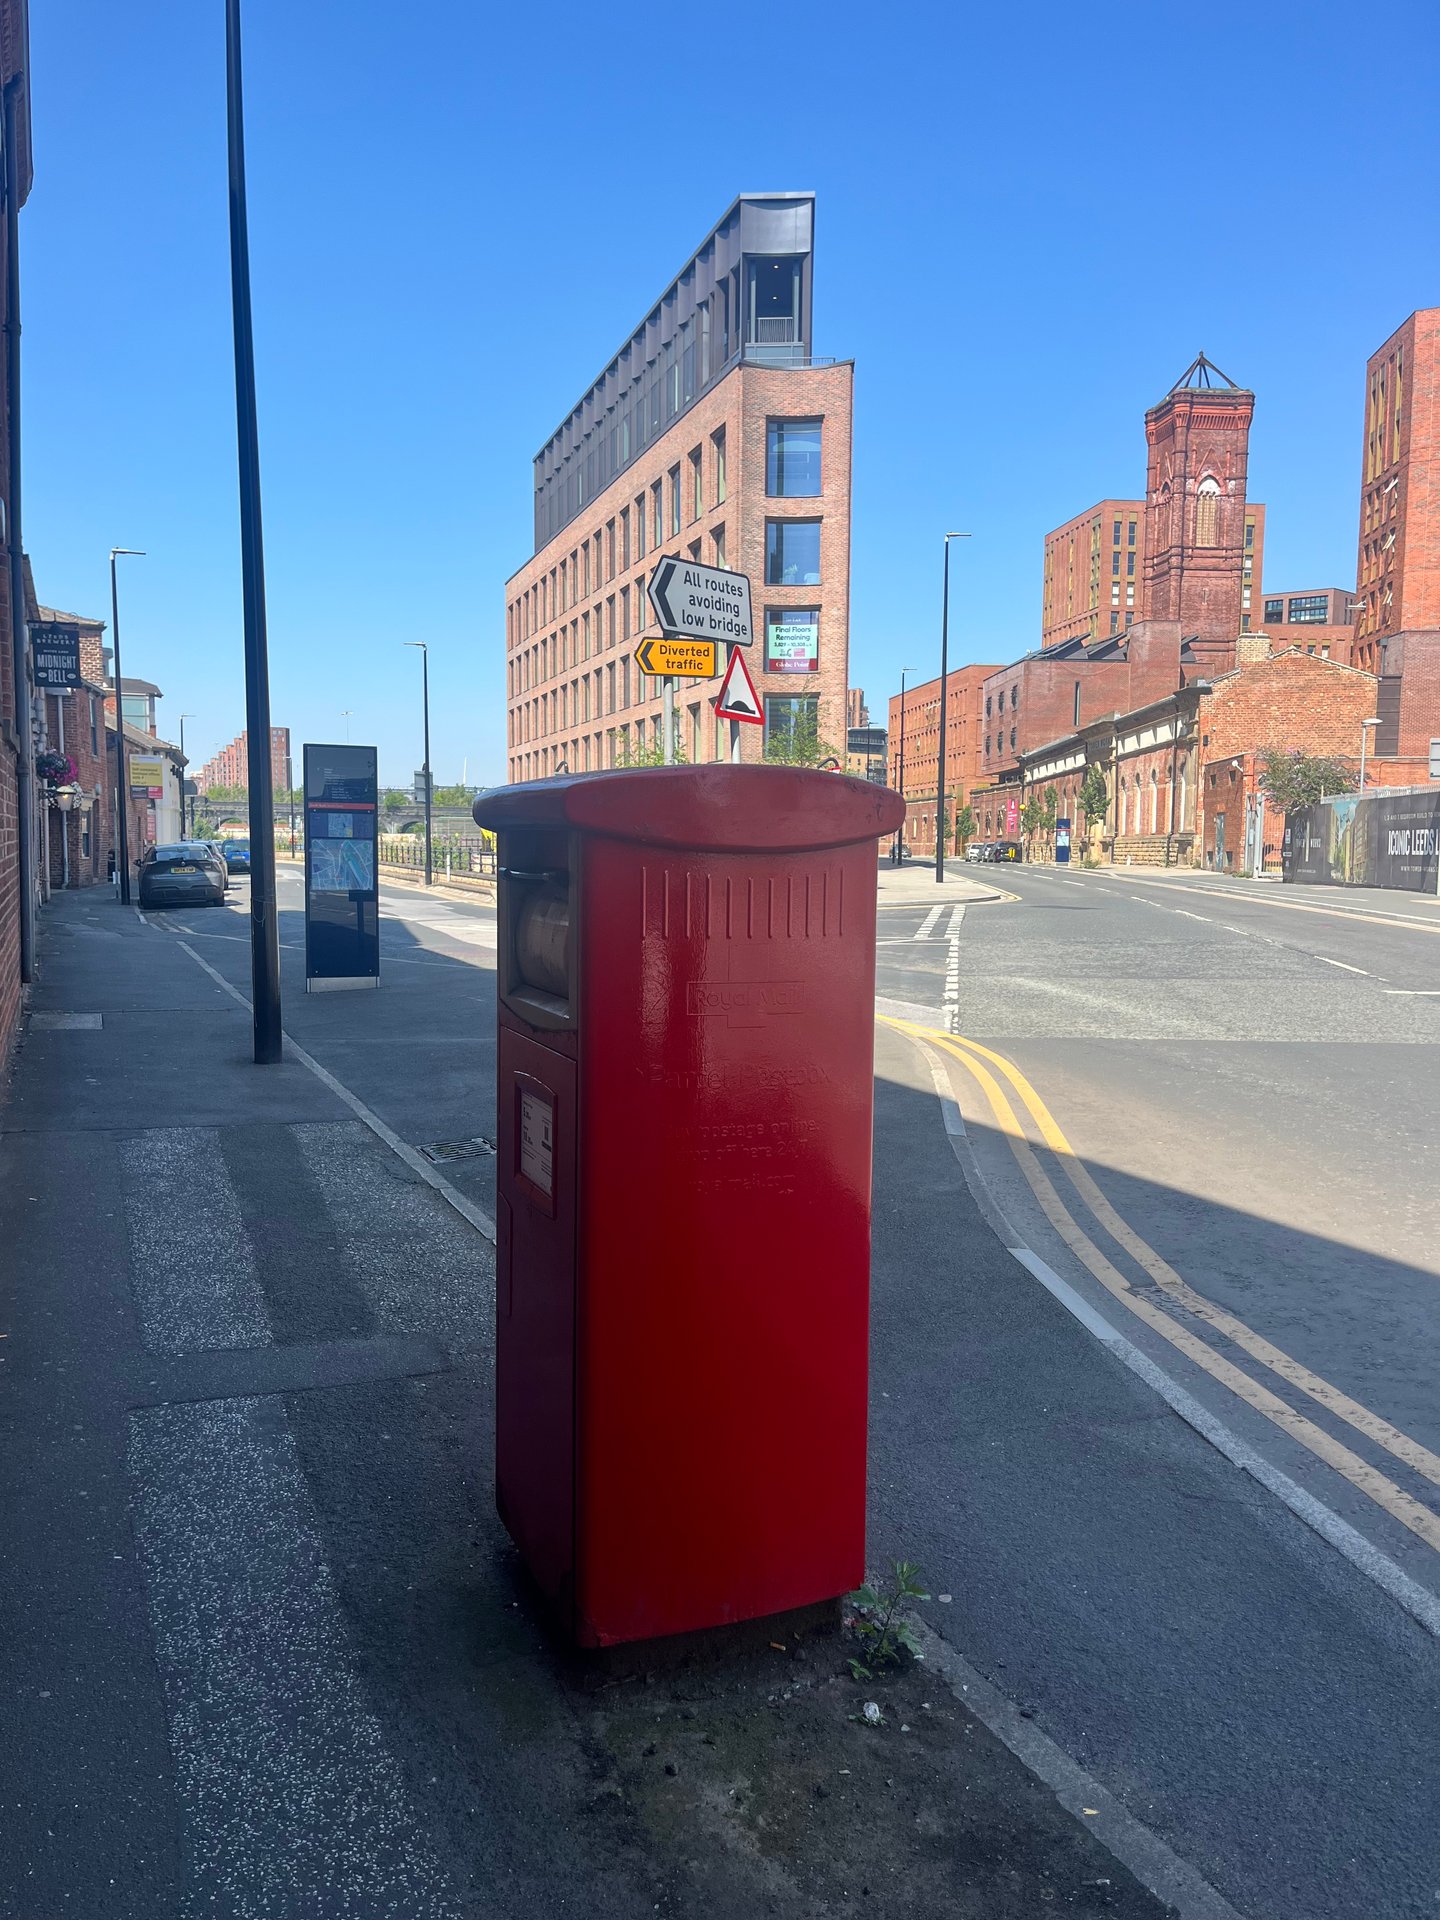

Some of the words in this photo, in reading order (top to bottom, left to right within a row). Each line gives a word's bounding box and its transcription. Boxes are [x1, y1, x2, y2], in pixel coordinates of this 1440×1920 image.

[684, 570, 701, 588] All
[705, 578, 743, 597] routes
[689, 594, 740, 618] avoiding
[682, 609, 705, 627] low
[709, 614, 748, 636] bridge
[37, 654, 77, 669] MIDNIGHT
[659, 645, 710, 657] Diverted
[665, 658, 703, 670] traffic
[48, 669, 68, 683] BELL
[1388, 829, 1410, 856] ICONIC
[1411, 829, 1435, 856] LEEDS
[696, 988, 751, 1010] Royal
[756, 985, 800, 1007] Mail
[697, 1121, 763, 1139] postage
